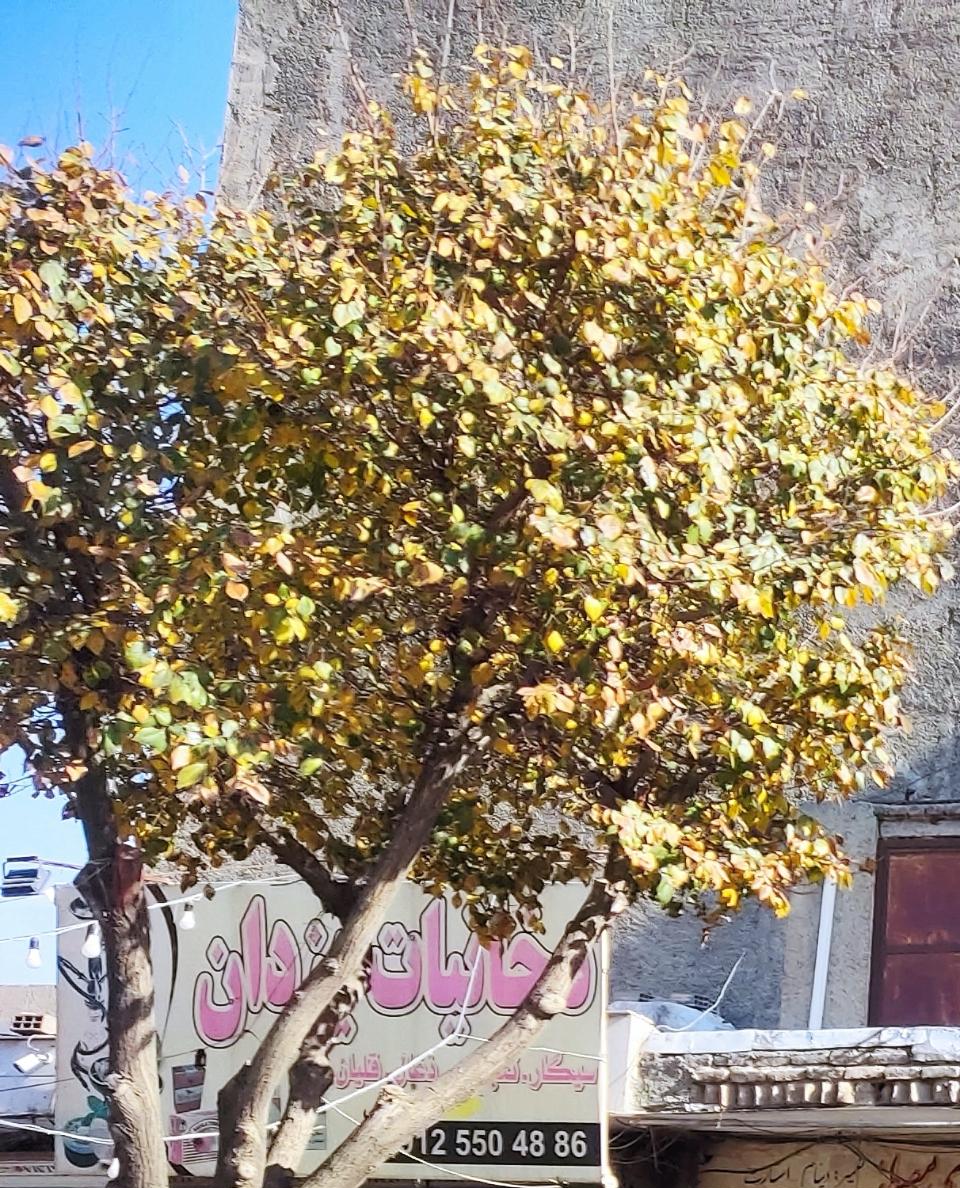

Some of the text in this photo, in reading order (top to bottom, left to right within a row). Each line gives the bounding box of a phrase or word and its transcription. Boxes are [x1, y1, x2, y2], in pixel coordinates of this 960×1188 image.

[454, 1128, 503, 1157] 550
[511, 1129, 546, 1159] 48
[553, 1130, 588, 1159] 86
